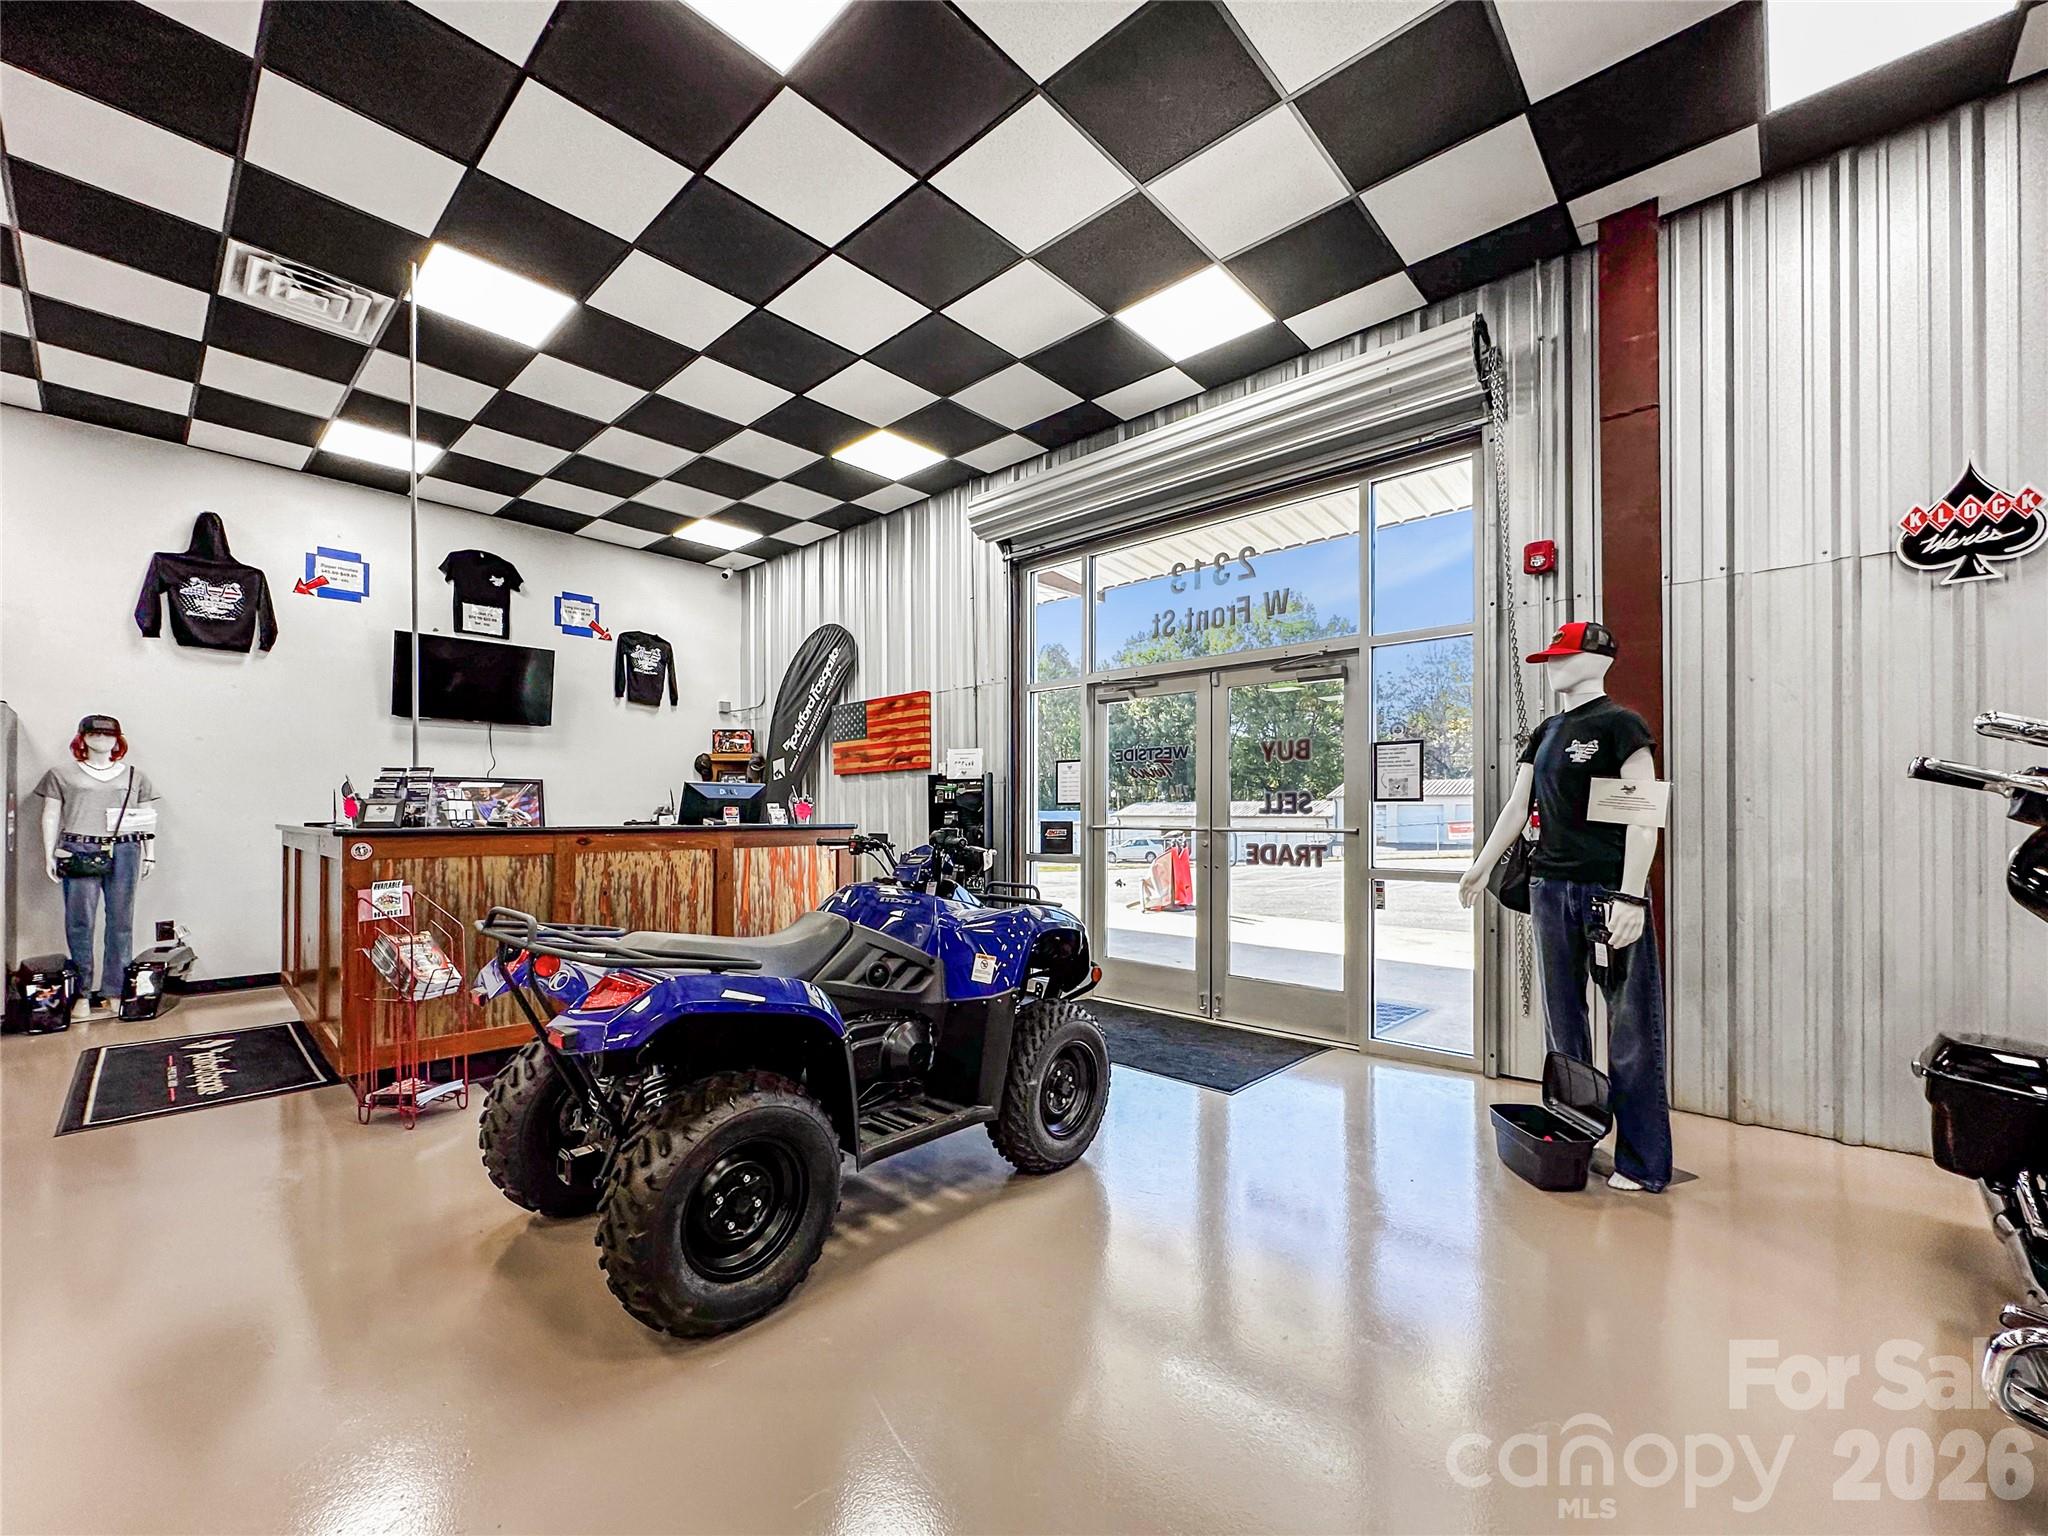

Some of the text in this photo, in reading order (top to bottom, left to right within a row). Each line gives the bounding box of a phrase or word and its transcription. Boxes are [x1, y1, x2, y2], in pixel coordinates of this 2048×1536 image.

[1909, 492, 2036, 528] KLOCK
[1920, 525, 2025, 554] Werks
[374, 880, 401, 891] AVAILABLE
